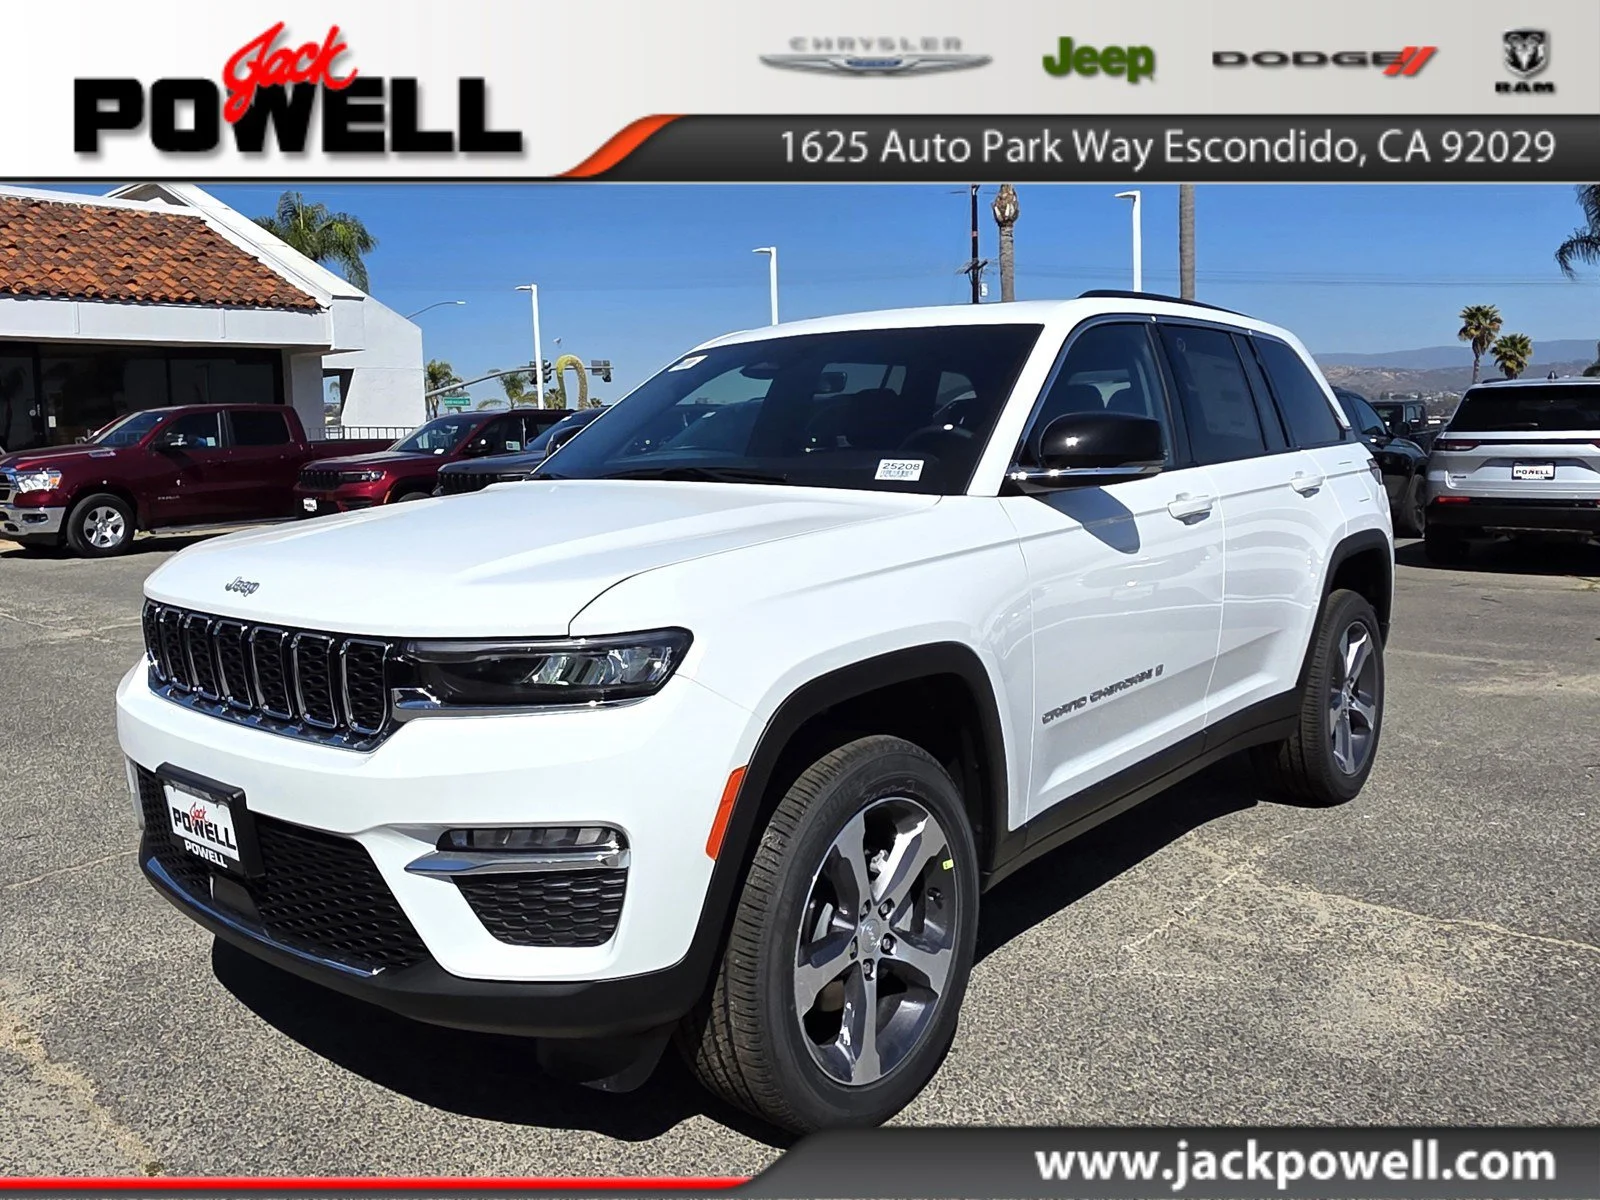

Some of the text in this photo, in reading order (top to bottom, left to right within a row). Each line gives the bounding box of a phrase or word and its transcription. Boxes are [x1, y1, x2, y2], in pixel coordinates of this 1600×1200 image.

[882, 462, 920, 471] 25208
[224, 576, 260, 598] Jeep
[172, 806, 237, 852] POWELL
[184, 839, 228, 868] POWELL
